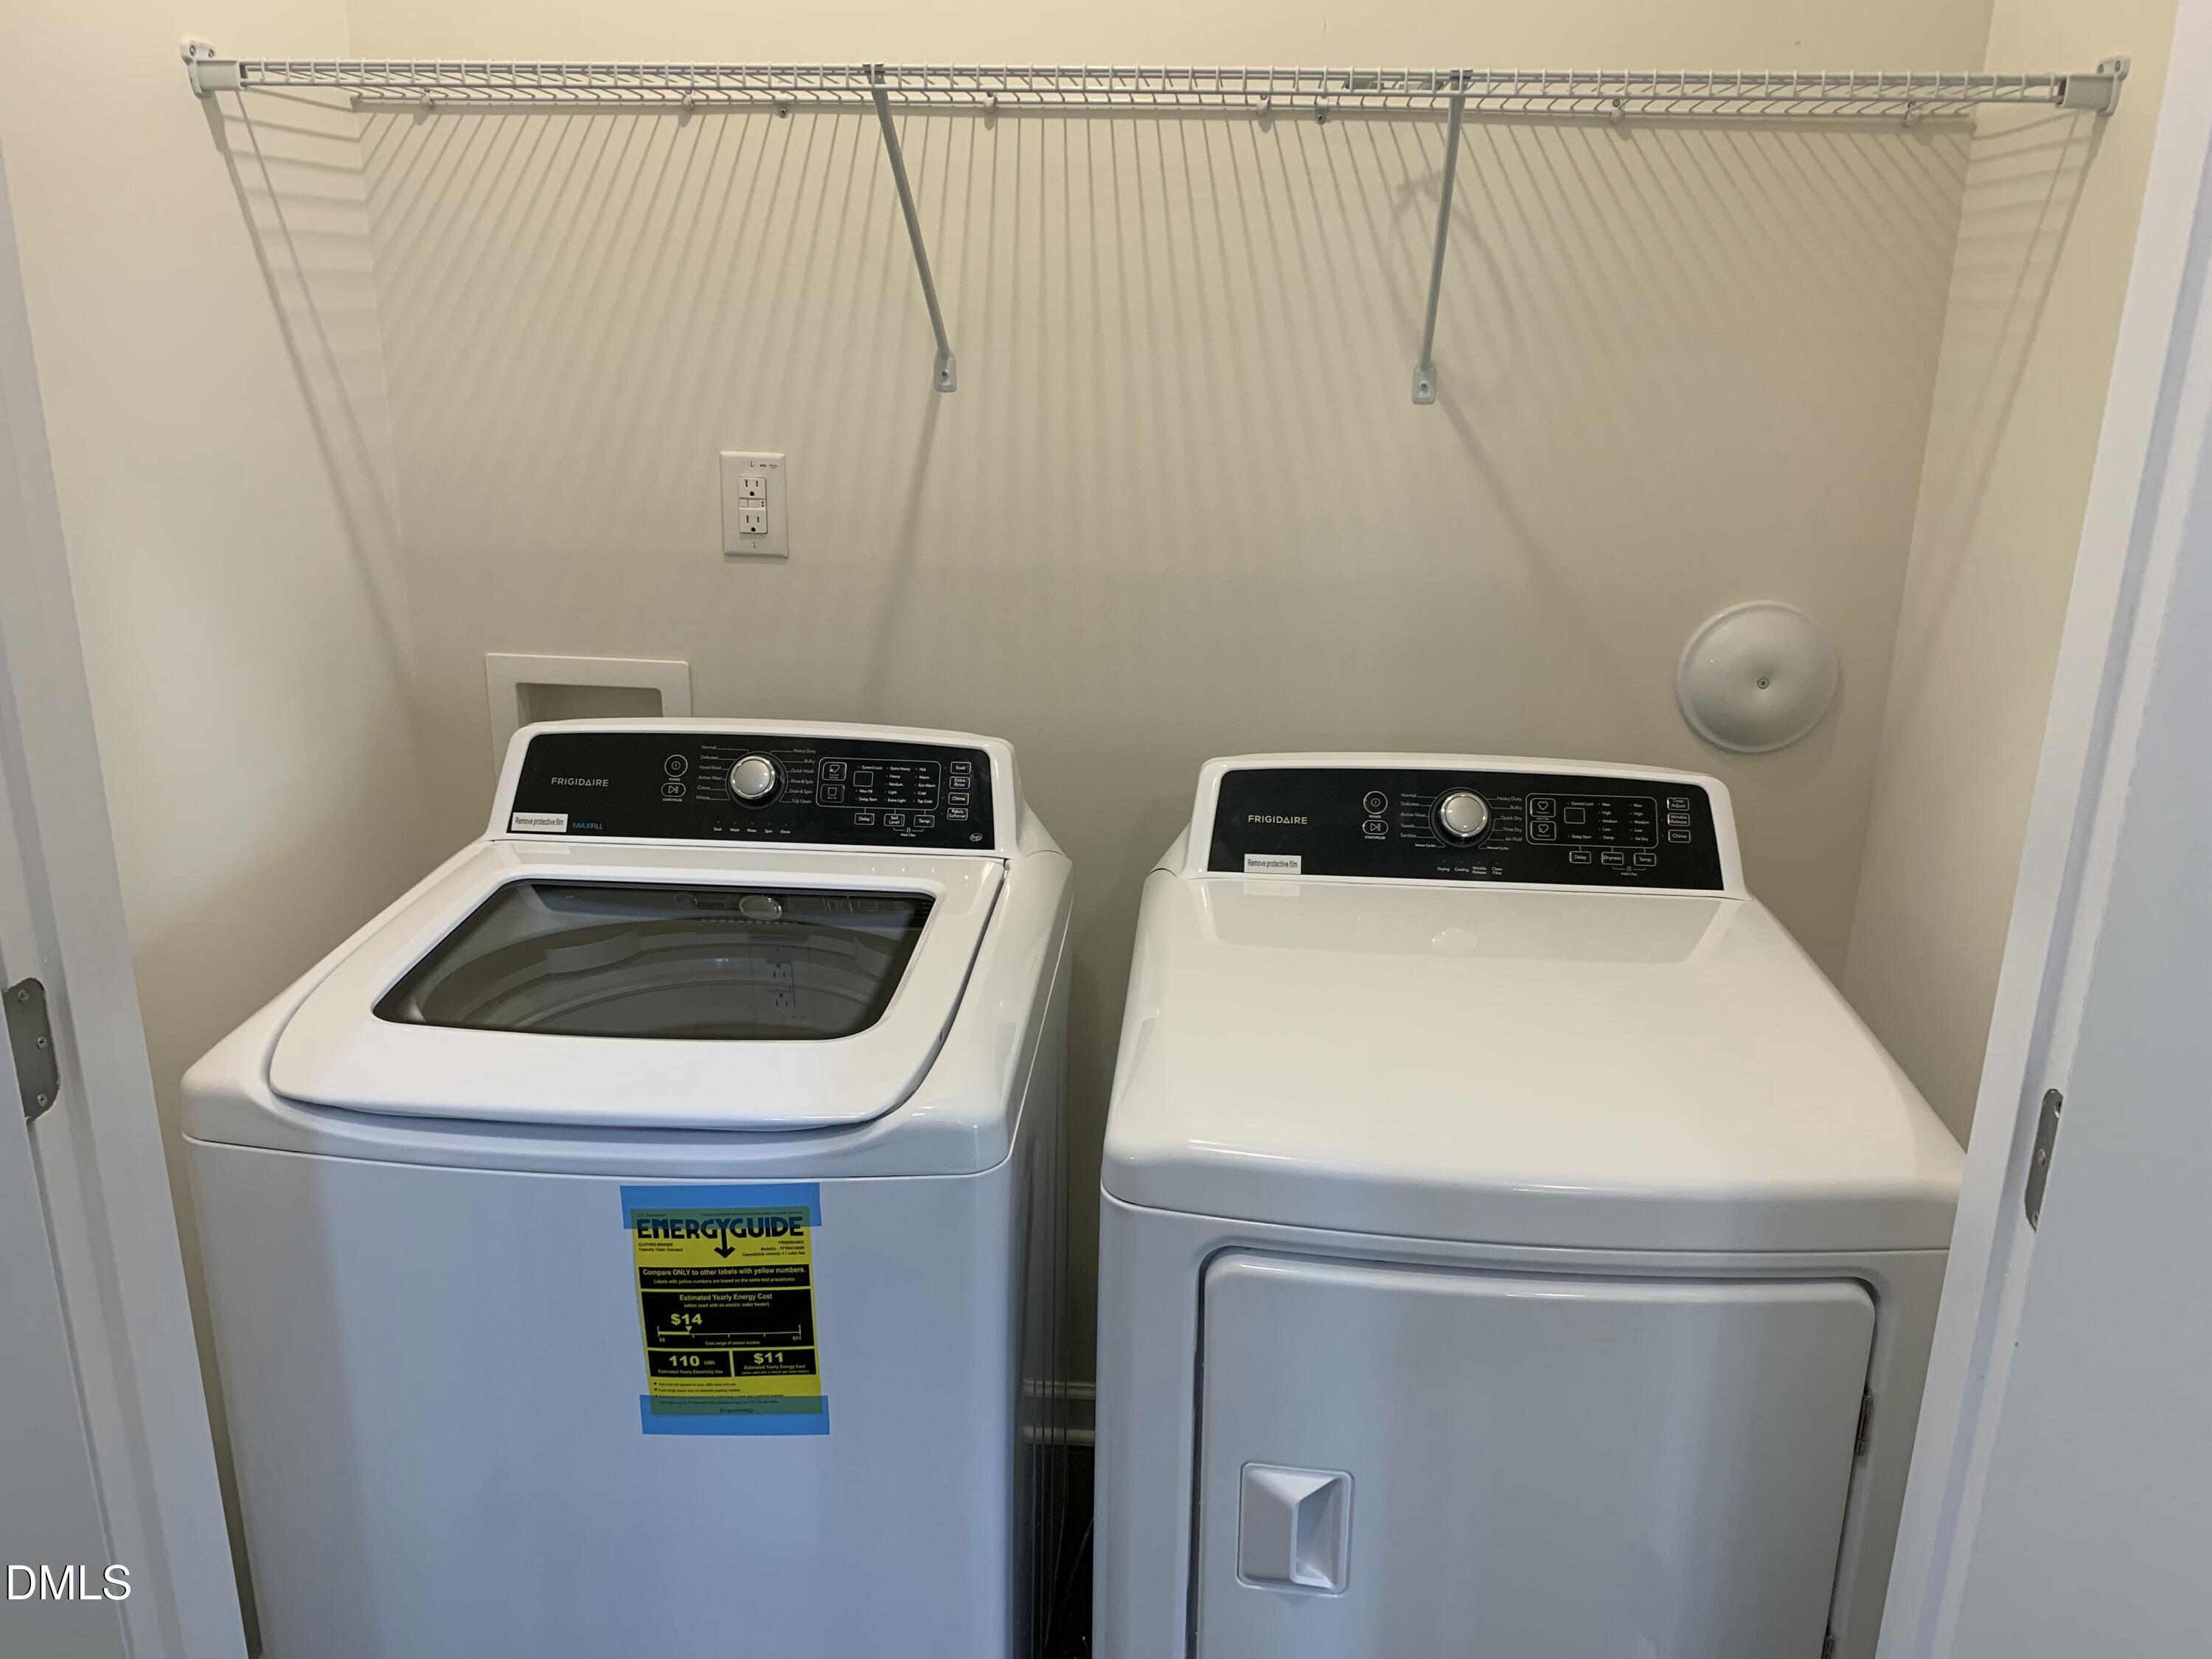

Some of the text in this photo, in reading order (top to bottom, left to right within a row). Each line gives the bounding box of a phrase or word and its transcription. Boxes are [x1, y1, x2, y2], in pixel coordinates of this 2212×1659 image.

[552, 777, 609, 787] FRIGIDAIRE
[515, 817, 564, 826] Remove protective film
[1248, 815, 1307, 824] FRIGIDAIRE
[1248, 859, 1298, 869] Remove protective film
[637, 1217, 804, 1239] ENERGYGUIDE
[754, 1267, 774, 1276] yellow
[671, 1313, 703, 1326] $14
[669, 1355, 700, 1366] 110
[754, 1352, 783, 1365] $11
